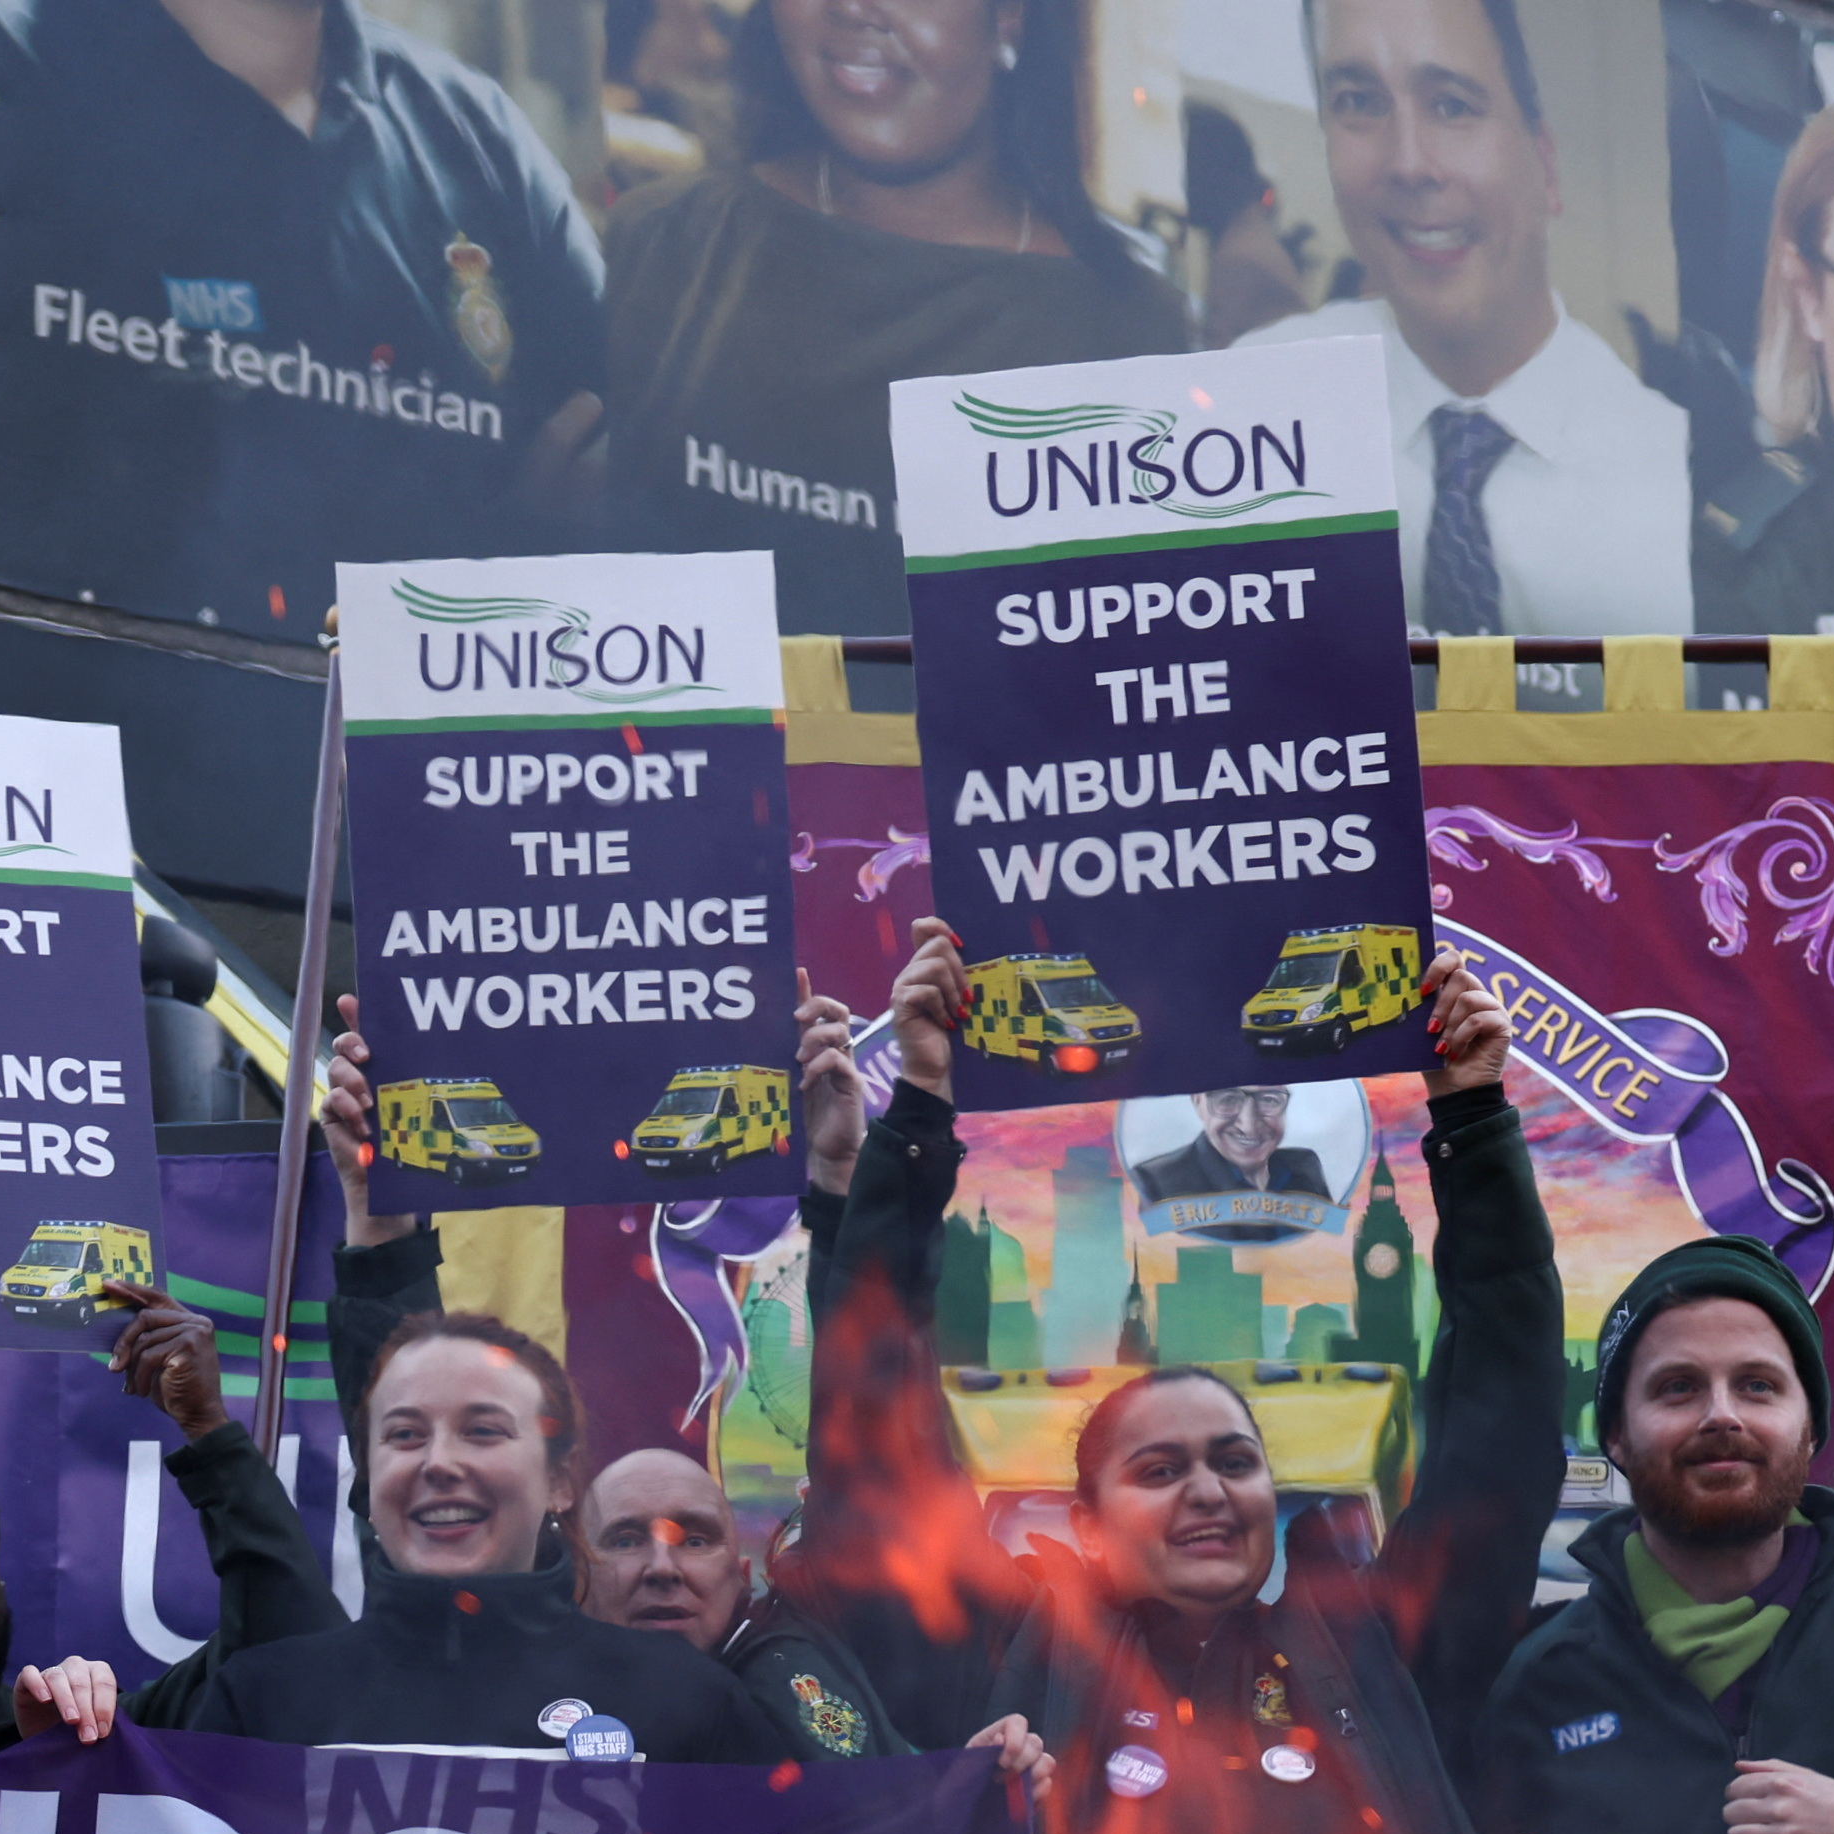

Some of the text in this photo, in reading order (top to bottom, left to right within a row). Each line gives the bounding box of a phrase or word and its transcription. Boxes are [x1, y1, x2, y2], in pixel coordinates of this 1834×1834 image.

[33, 285, 503, 440] Fleet technician
[684, 436, 878, 529] Human
[987, 419, 1307, 518] UNISON
[996, 567, 1316, 646] SUPPORT
[420, 625, 706, 691] UNISON
[1095, 660, 1231, 725] THE
[423, 750, 708, 809] SUPPORT
[953, 731, 1391, 826] AMBULANCE
[510, 830, 631, 876] THE
[978, 814, 1376, 905] WORKERS
[381, 896, 769, 958] AMBULANCE
[400, 966, 756, 1032] WORKERS
[1490, 970, 1661, 1120] SERVICE
[1171, 1197, 1325, 1226] ERIC ROBERTS
[574, 1742, 627, 1757] NHS STAFF
[577, 1732, 603, 1745] STAND
[603, 1731, 627, 1744] WITH
[1557, 1712, 1616, 1750] NHS
